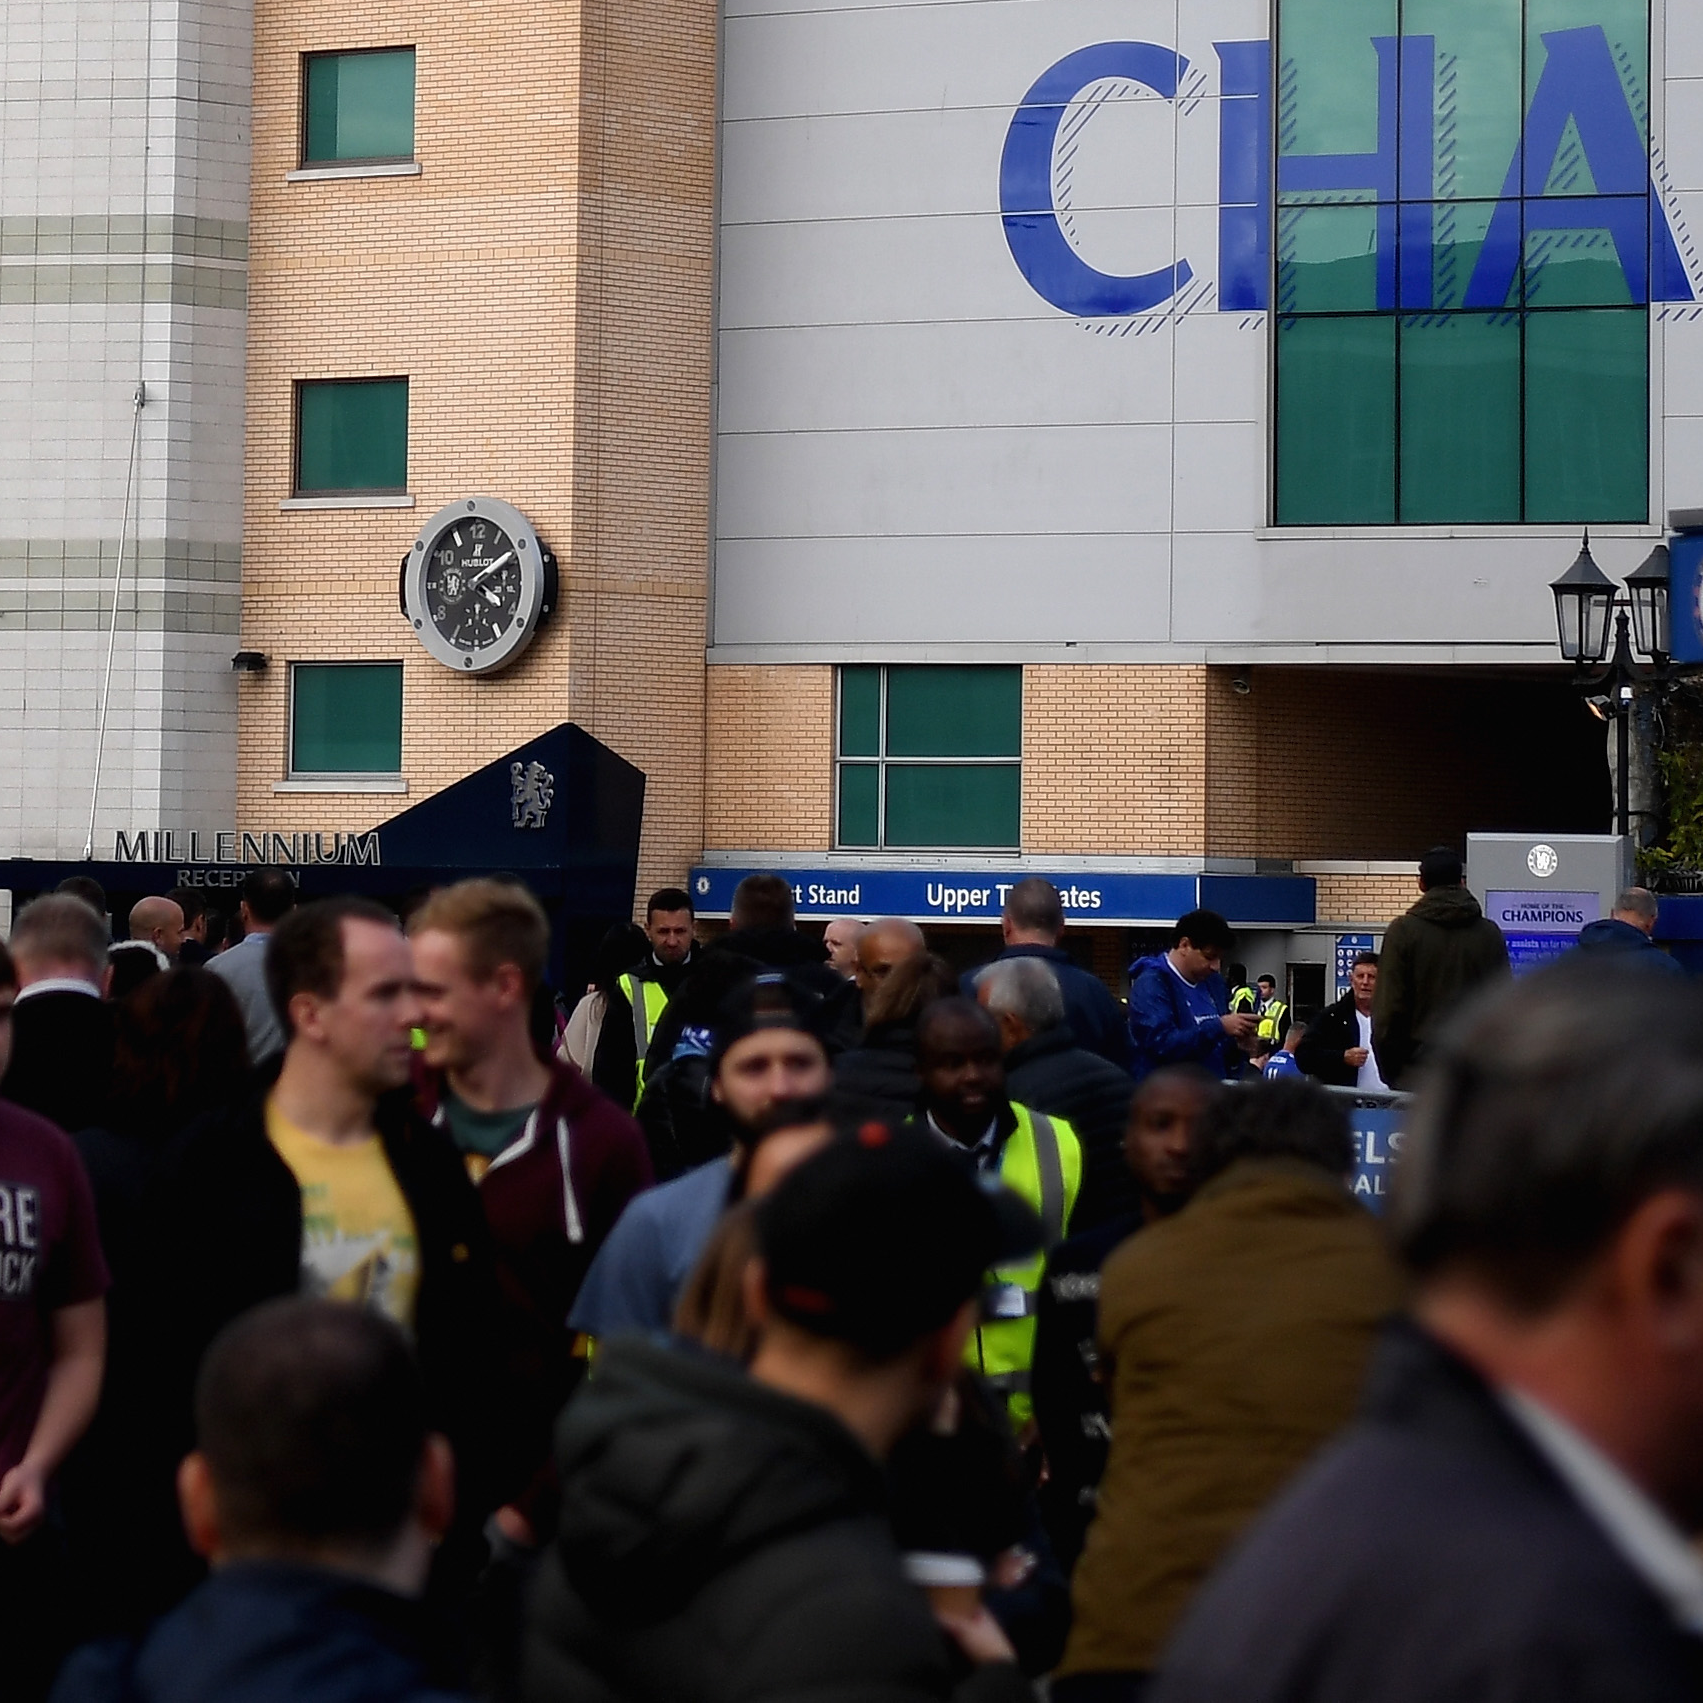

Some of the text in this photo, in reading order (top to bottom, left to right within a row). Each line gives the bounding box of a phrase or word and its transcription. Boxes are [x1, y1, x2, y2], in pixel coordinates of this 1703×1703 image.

[469, 523, 486, 539] 12
[438, 549, 454, 566] 10
[461, 558, 494, 568] HUBLOT
[113, 829, 382, 866] MILLENNIUM
[176, 869, 301, 889] RECEPN
[808, 883, 861, 906] Stand
[926, 883, 991, 913] Upper
[1054, 885, 1102, 909] ates
[1502, 910, 1584, 923] CHAMPIONS
